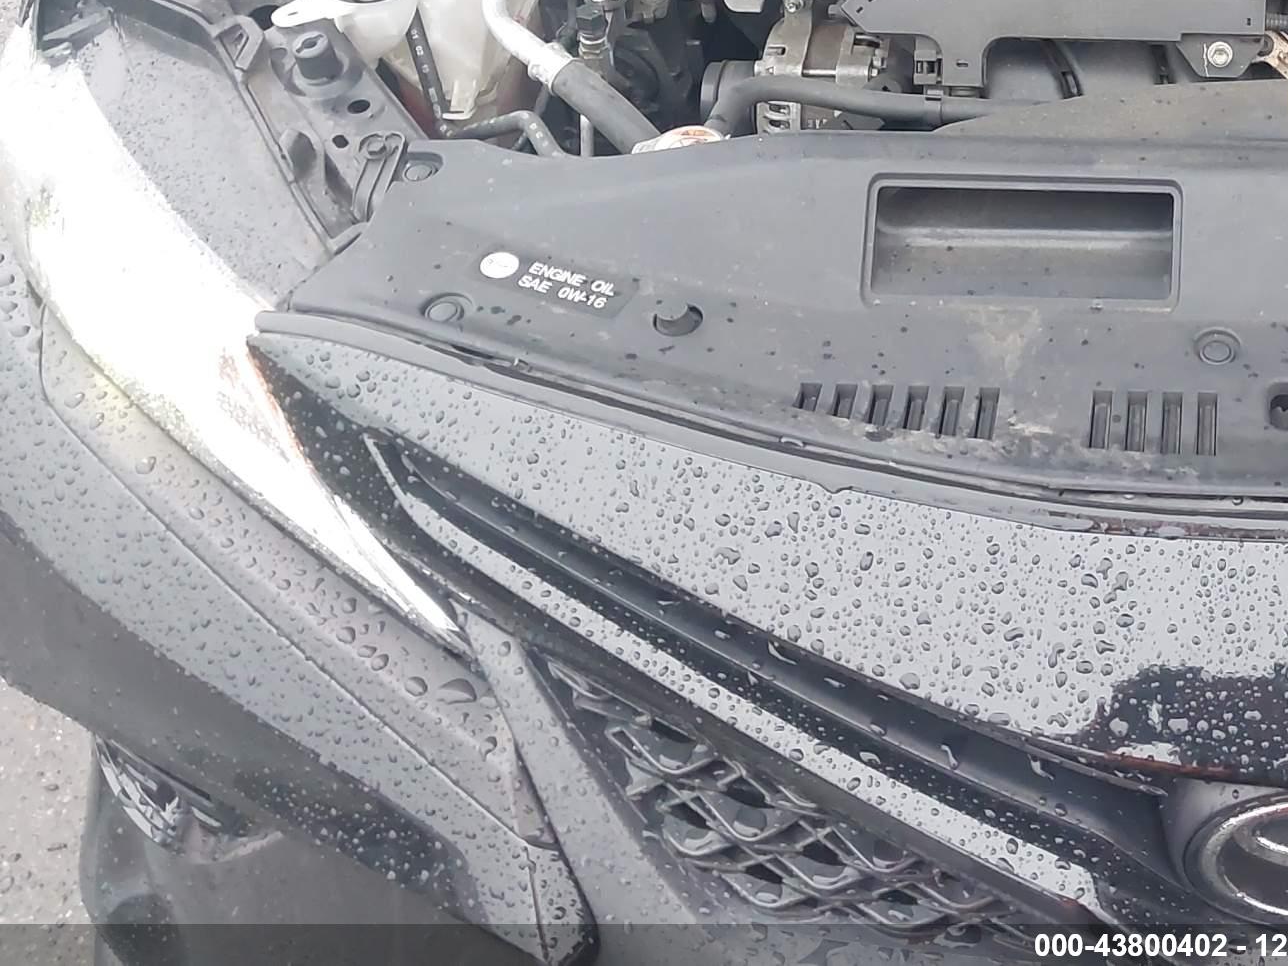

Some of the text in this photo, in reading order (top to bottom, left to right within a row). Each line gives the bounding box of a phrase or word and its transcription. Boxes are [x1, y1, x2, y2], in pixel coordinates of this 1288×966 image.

[518, 275, 607, 309] SAE 0W-16
[528, 261, 615, 296] ENGINE OIL
